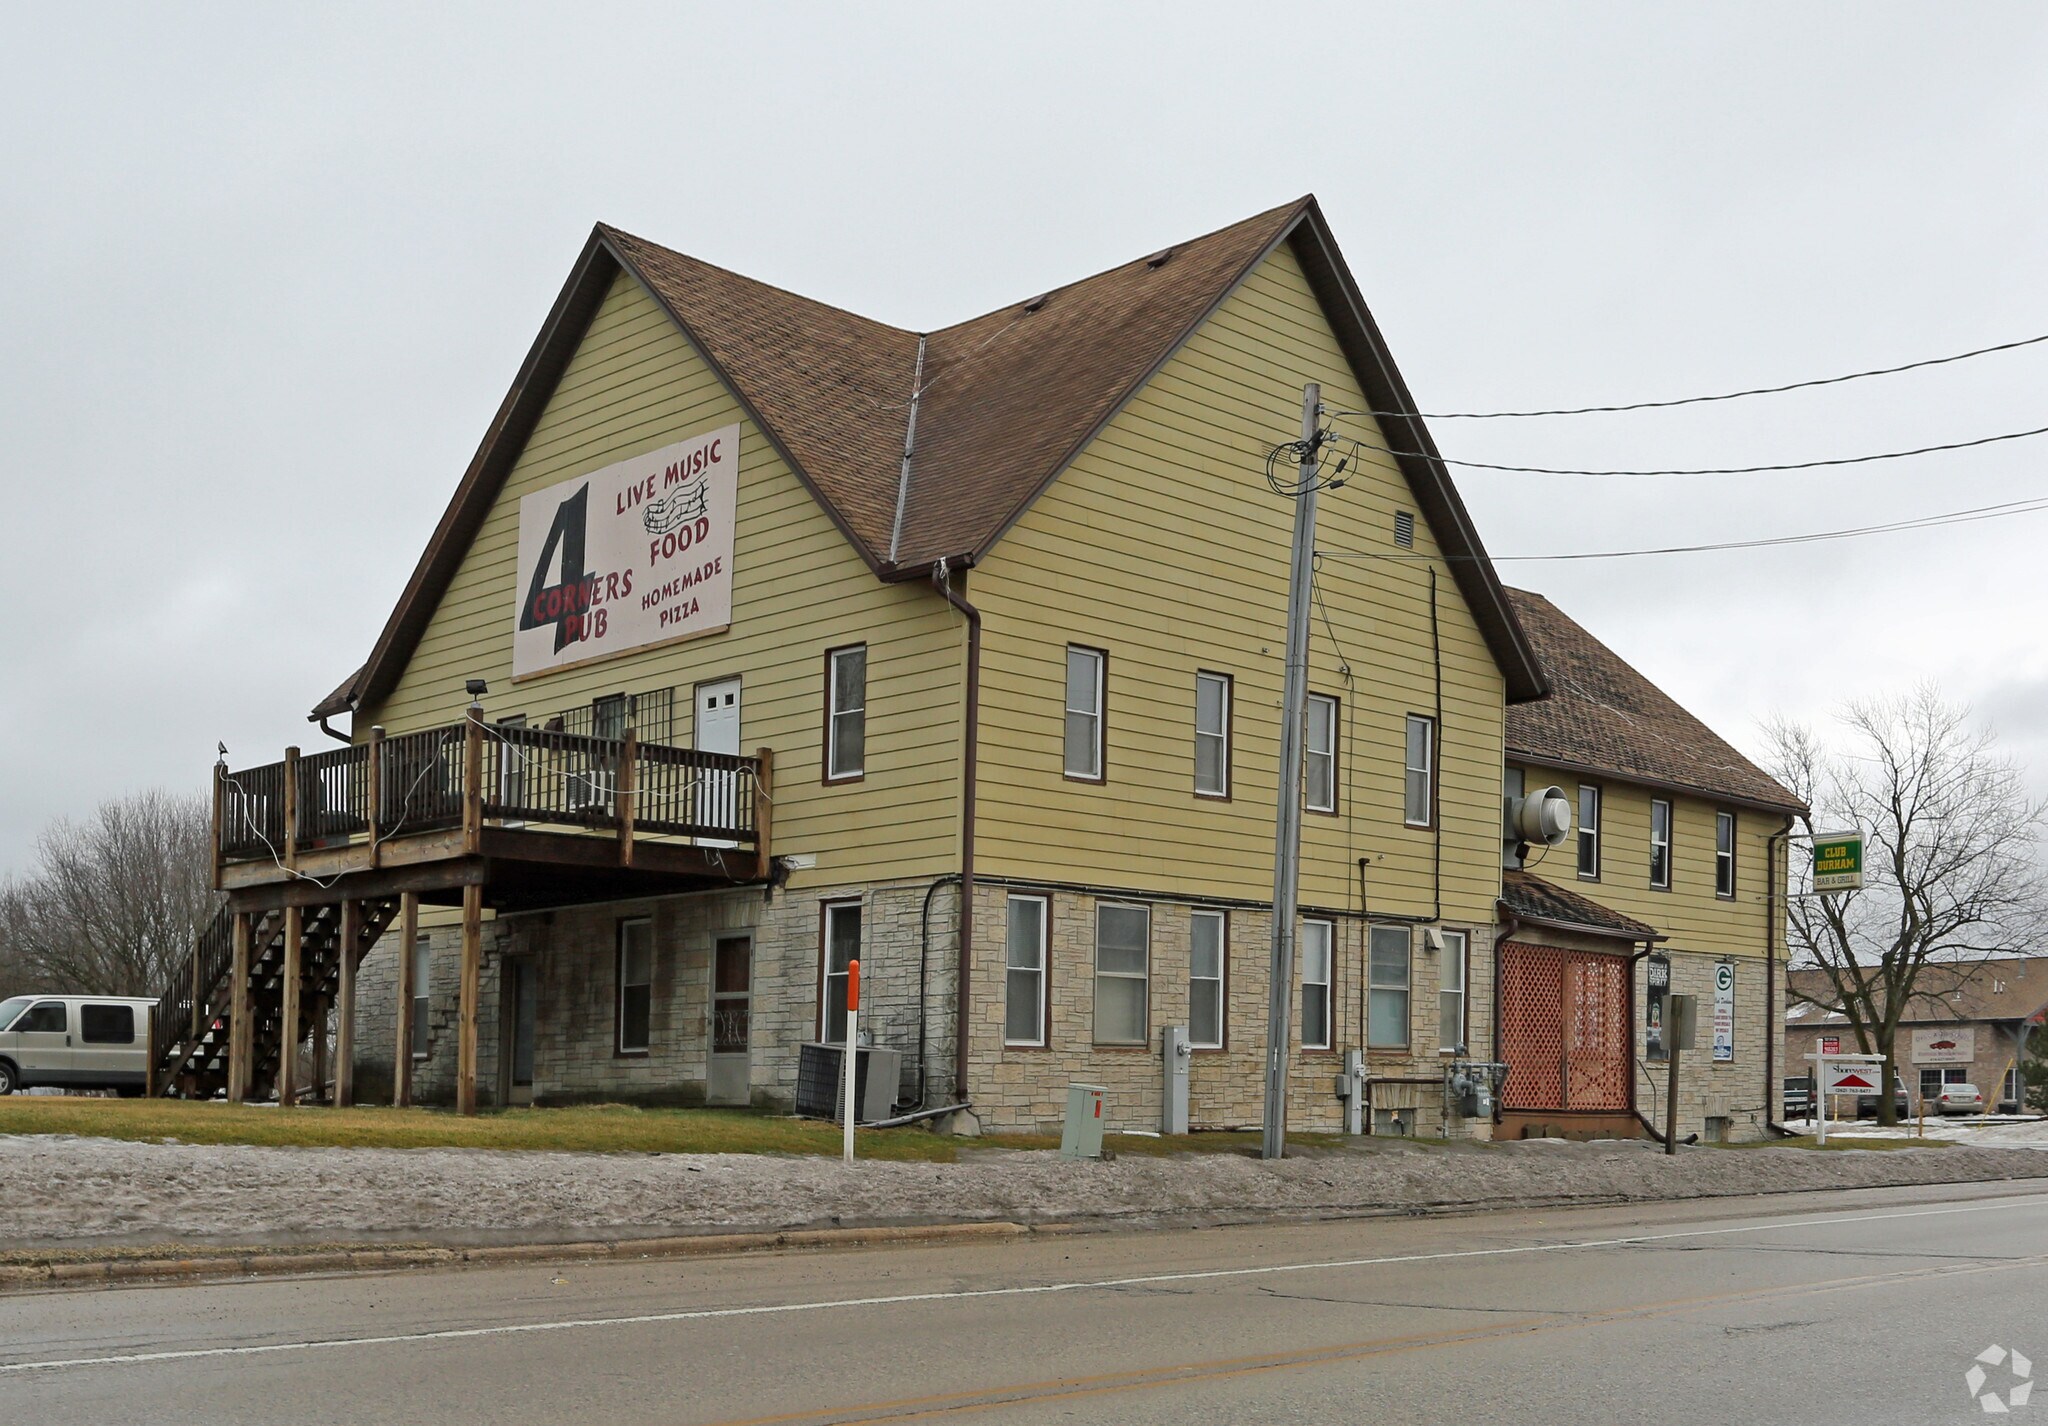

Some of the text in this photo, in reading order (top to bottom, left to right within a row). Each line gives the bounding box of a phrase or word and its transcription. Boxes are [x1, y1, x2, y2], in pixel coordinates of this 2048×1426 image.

[616, 438, 722, 516] LIVE MUSIC
[650, 516, 710, 567] FOOD
[519, 481, 596, 656] 4
[641, 556, 722, 611] HOMEMADE
[533, 568, 633, 622] CORNERS
[659, 597, 699, 629] PIZZA
[564, 608, 608, 645] PUB
[1817, 858, 1855, 871] DURHAM
[1825, 846, 1847, 858] CLUB
[1816, 877, 1830, 886] BAR
